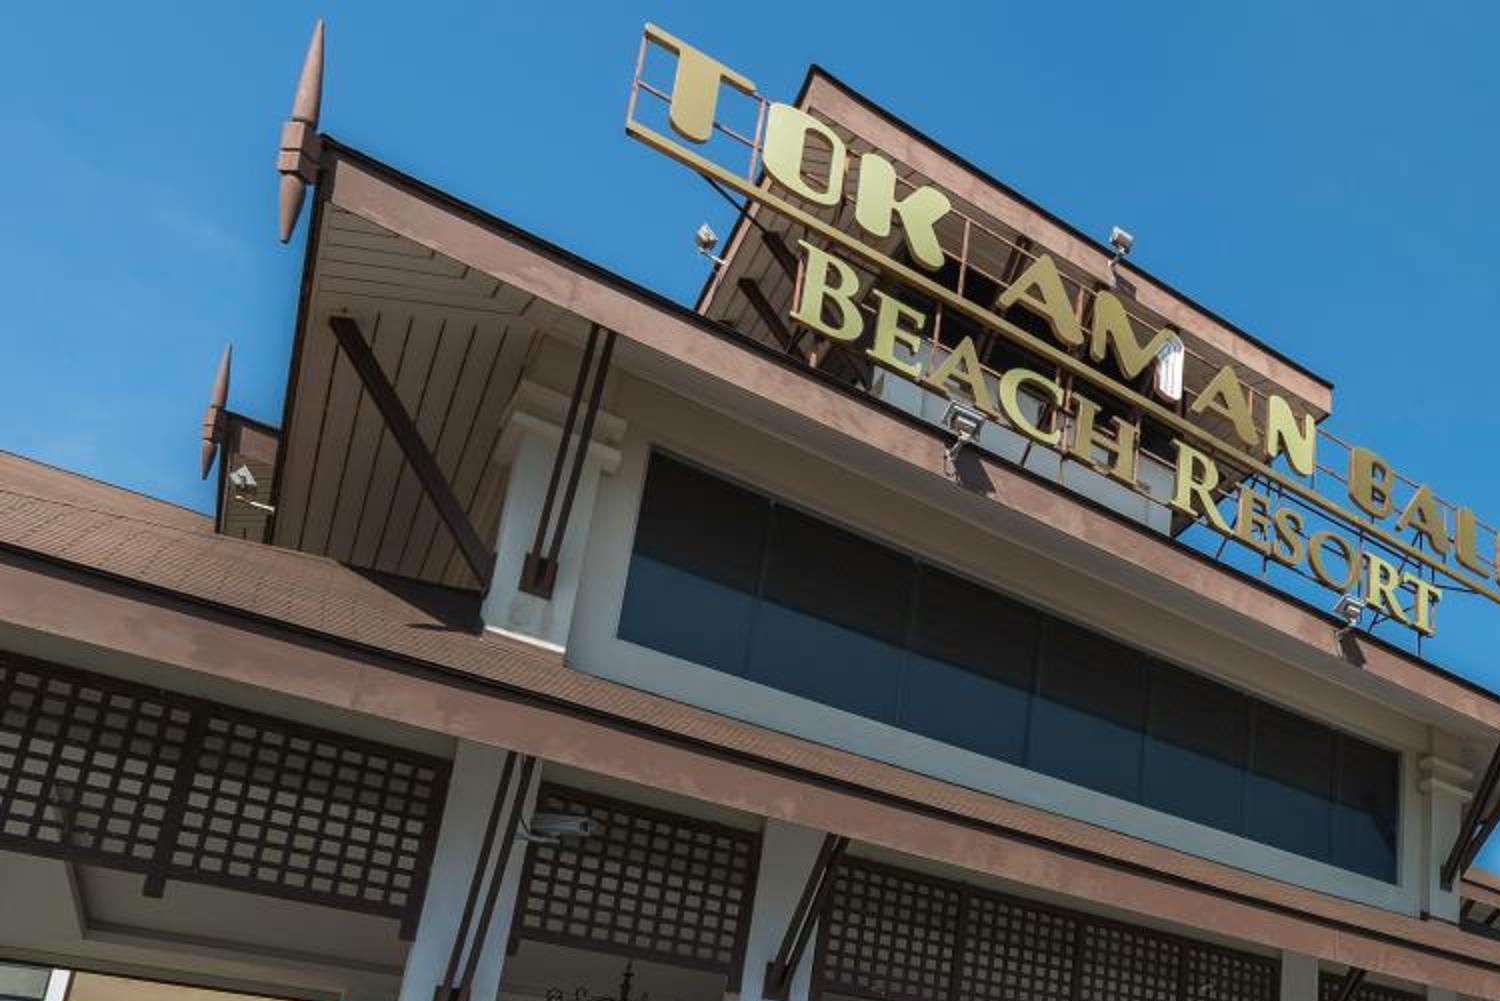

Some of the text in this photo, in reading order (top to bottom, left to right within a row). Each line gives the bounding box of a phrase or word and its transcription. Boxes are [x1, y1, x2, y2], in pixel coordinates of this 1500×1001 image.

[645, 22, 951, 271] TOK
[997, 254, 1315, 476] AMAN
[790, 239, 1443, 637] BEACH RESORT
